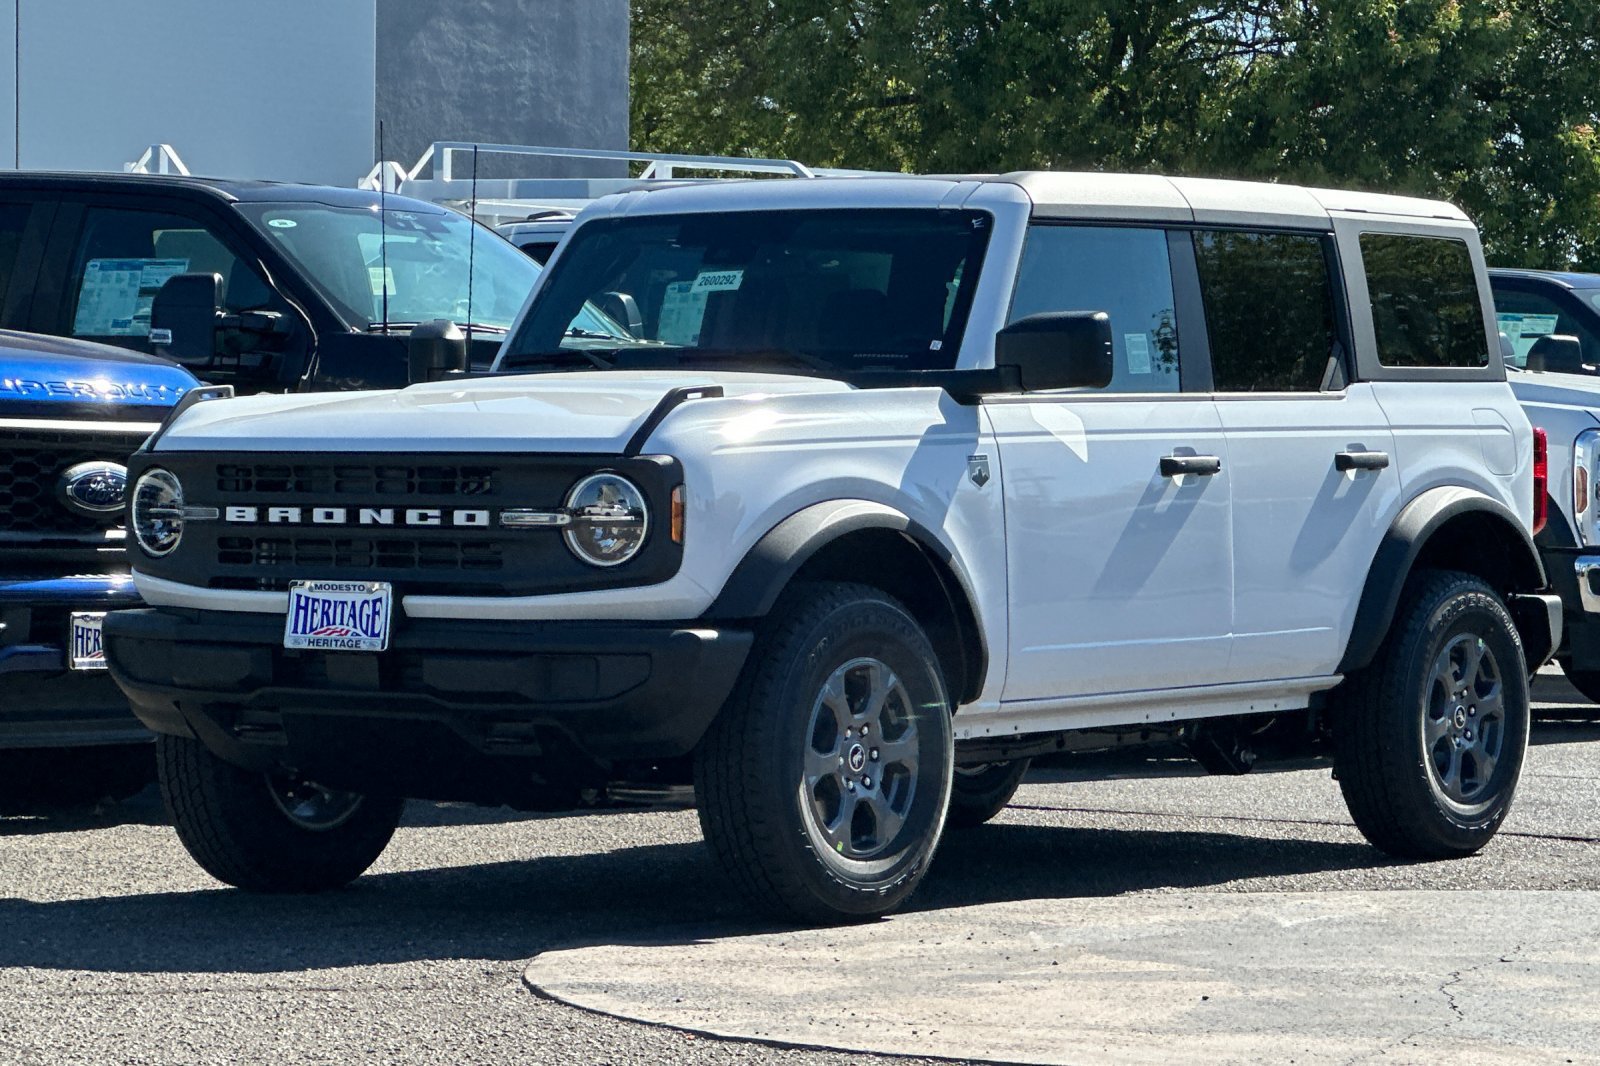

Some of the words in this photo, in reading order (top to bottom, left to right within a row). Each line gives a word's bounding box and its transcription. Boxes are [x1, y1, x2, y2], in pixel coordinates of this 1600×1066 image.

[698, 274, 737, 287] 2600292
[226, 506, 490, 526] BRONCO
[314, 583, 365, 592] MODESTO
[291, 593, 383, 637] HERITAGE
[307, 639, 361, 649] HERITAGE
